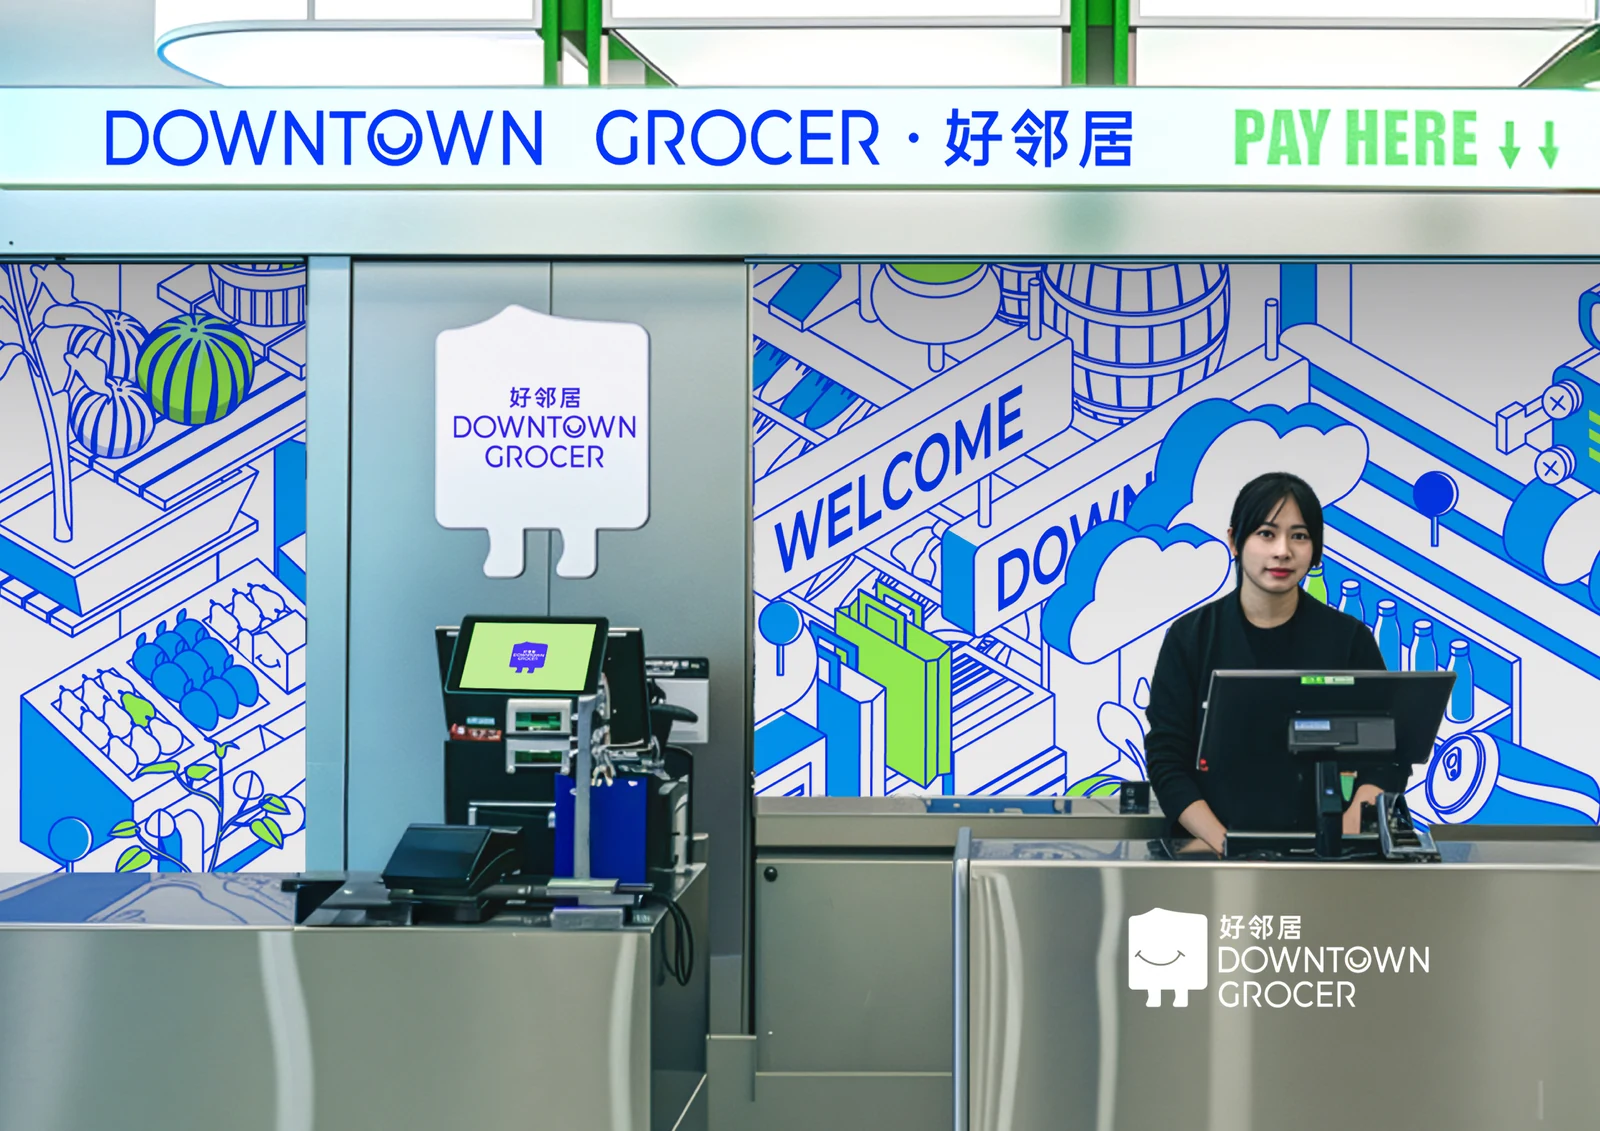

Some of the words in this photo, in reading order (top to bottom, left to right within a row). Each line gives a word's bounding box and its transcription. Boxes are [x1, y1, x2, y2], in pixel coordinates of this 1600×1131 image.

[105, 108, 543, 167] DOWNTOWN
[595, 108, 880, 167] GROCER
[944, 107, 1133, 169] 好邻居
[1234, 108, 1332, 167] PAY
[1345, 108, 1478, 167] HERE
[509, 386, 581, 409] 好邻居
[453, 415, 636, 439] DOWNTOWN
[485, 445, 604, 468] GROCER
[774, 384, 1024, 574] WELCOME
[1219, 914, 1302, 940] 好邻居
[1218, 945, 1430, 974] DOWNTOWN
[1218, 980, 1356, 1008] GROCER
